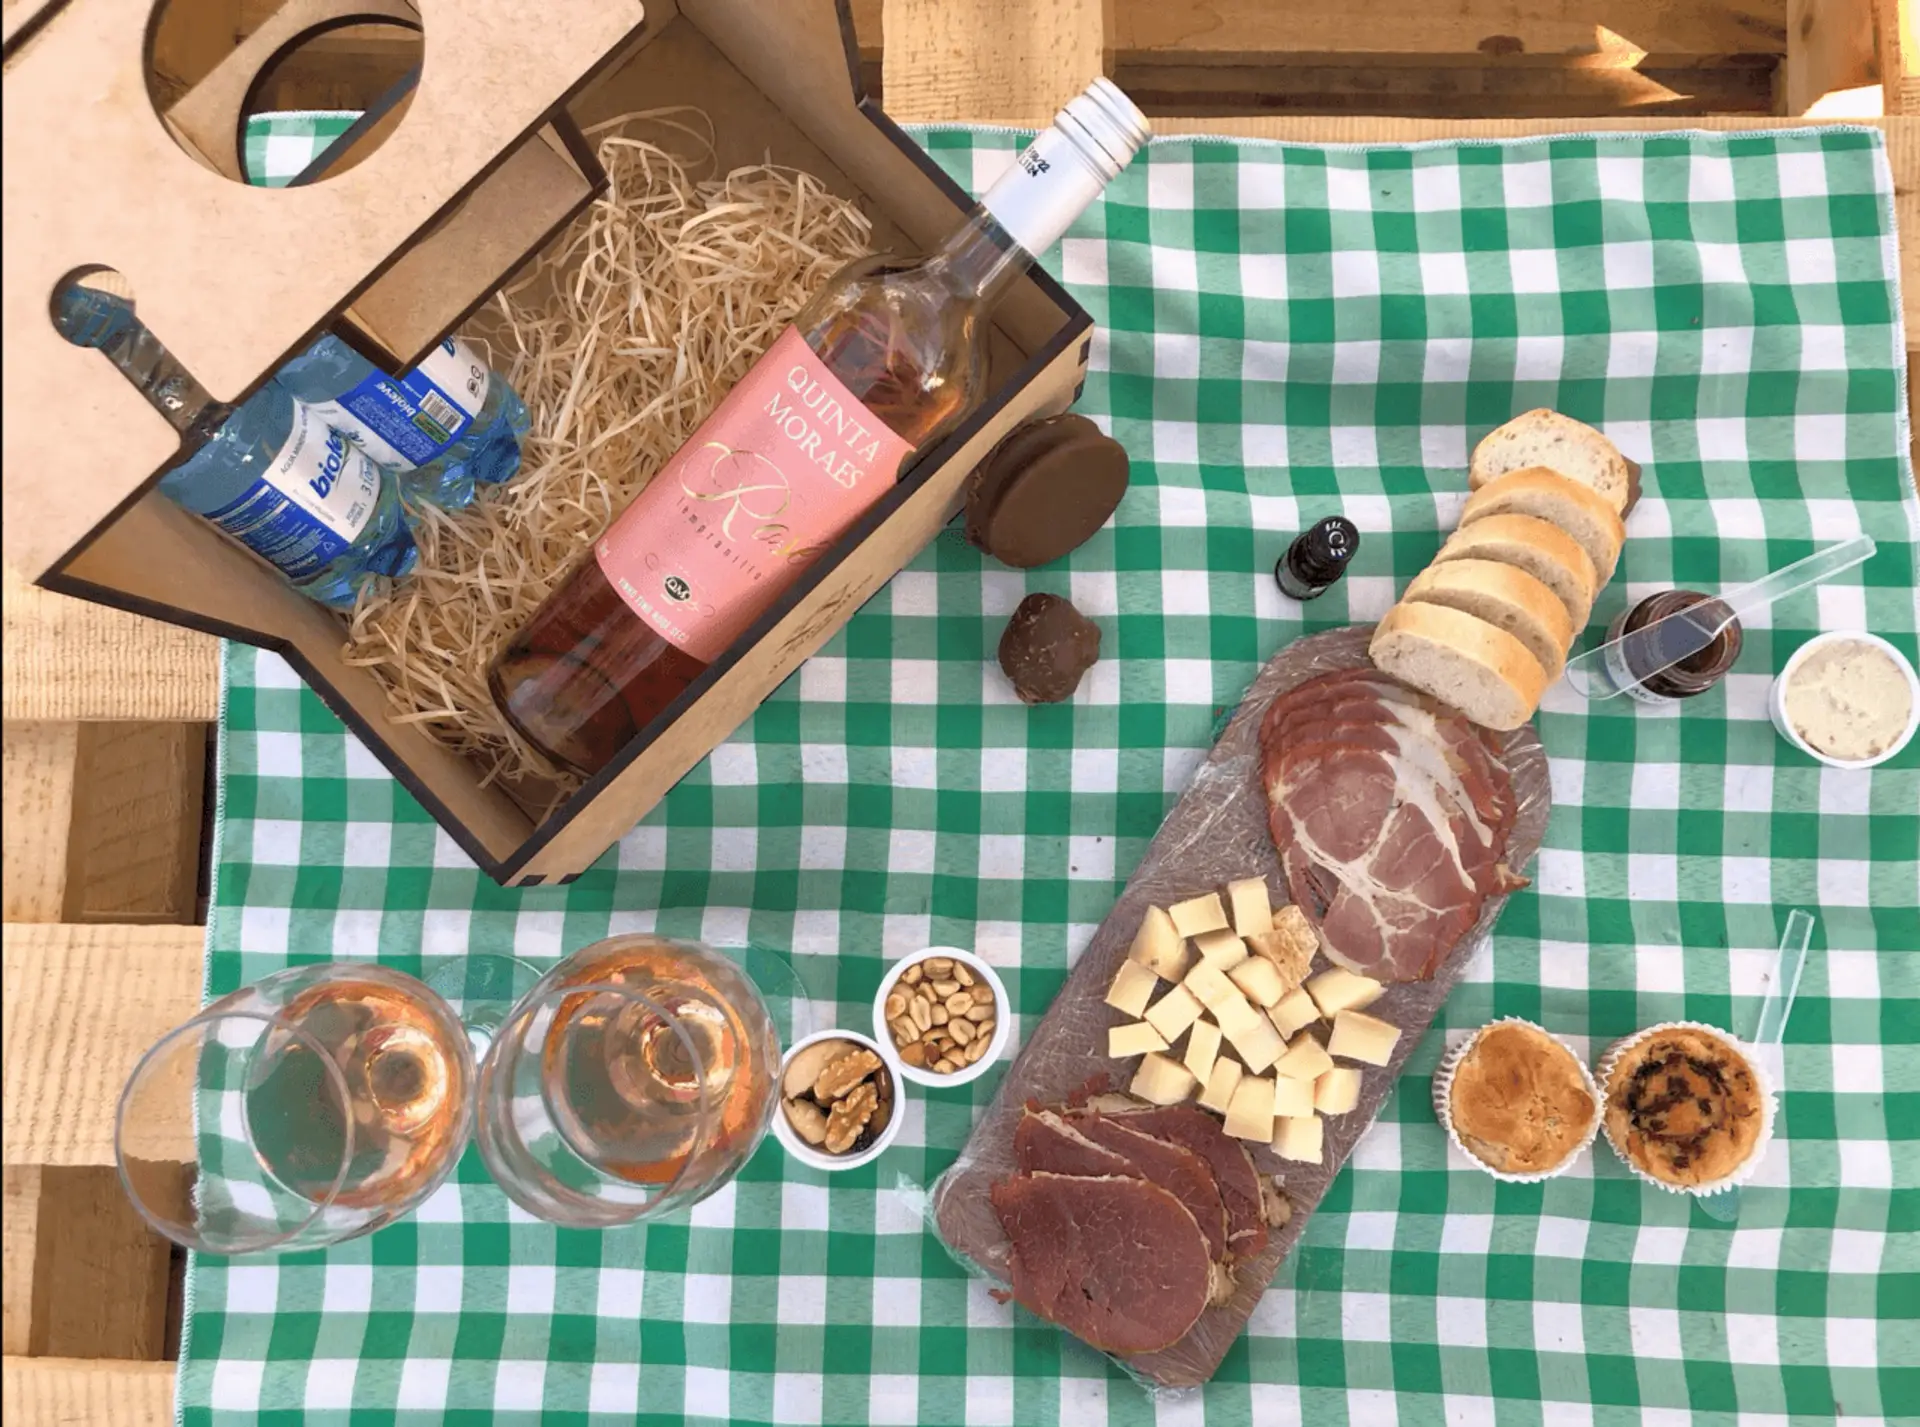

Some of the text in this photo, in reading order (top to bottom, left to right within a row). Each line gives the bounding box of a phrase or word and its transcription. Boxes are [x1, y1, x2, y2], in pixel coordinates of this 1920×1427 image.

[374, 380, 417, 418] bioleve
[763, 391, 864, 489] MORAES
[787, 365, 880, 463] QUINTA
